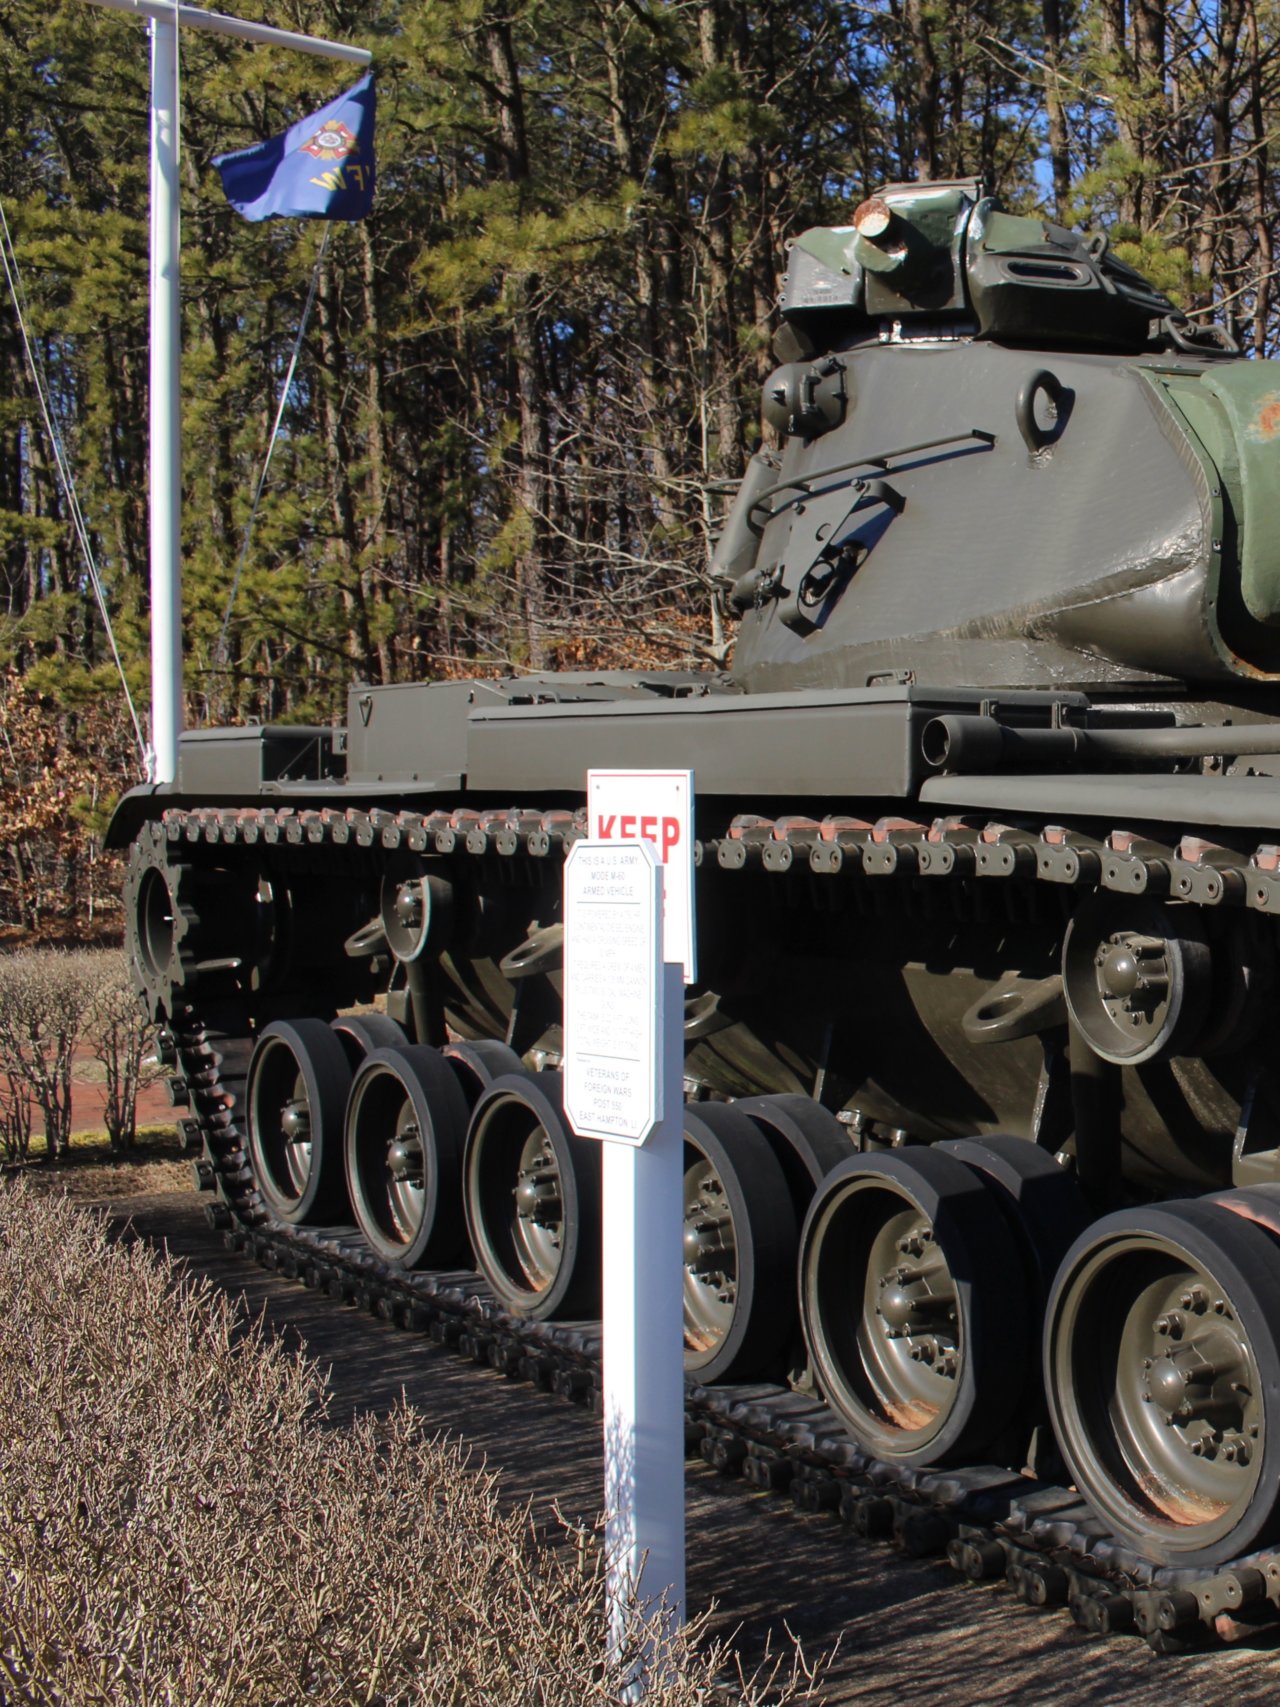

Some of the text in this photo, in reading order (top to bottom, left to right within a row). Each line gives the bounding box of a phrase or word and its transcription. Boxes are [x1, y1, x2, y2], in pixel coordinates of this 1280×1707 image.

[607, 886, 634, 897] VEHICLE
[586, 1067, 619, 1080] VETERANS
[584, 1081, 632, 1098] FOREIGN WARS
